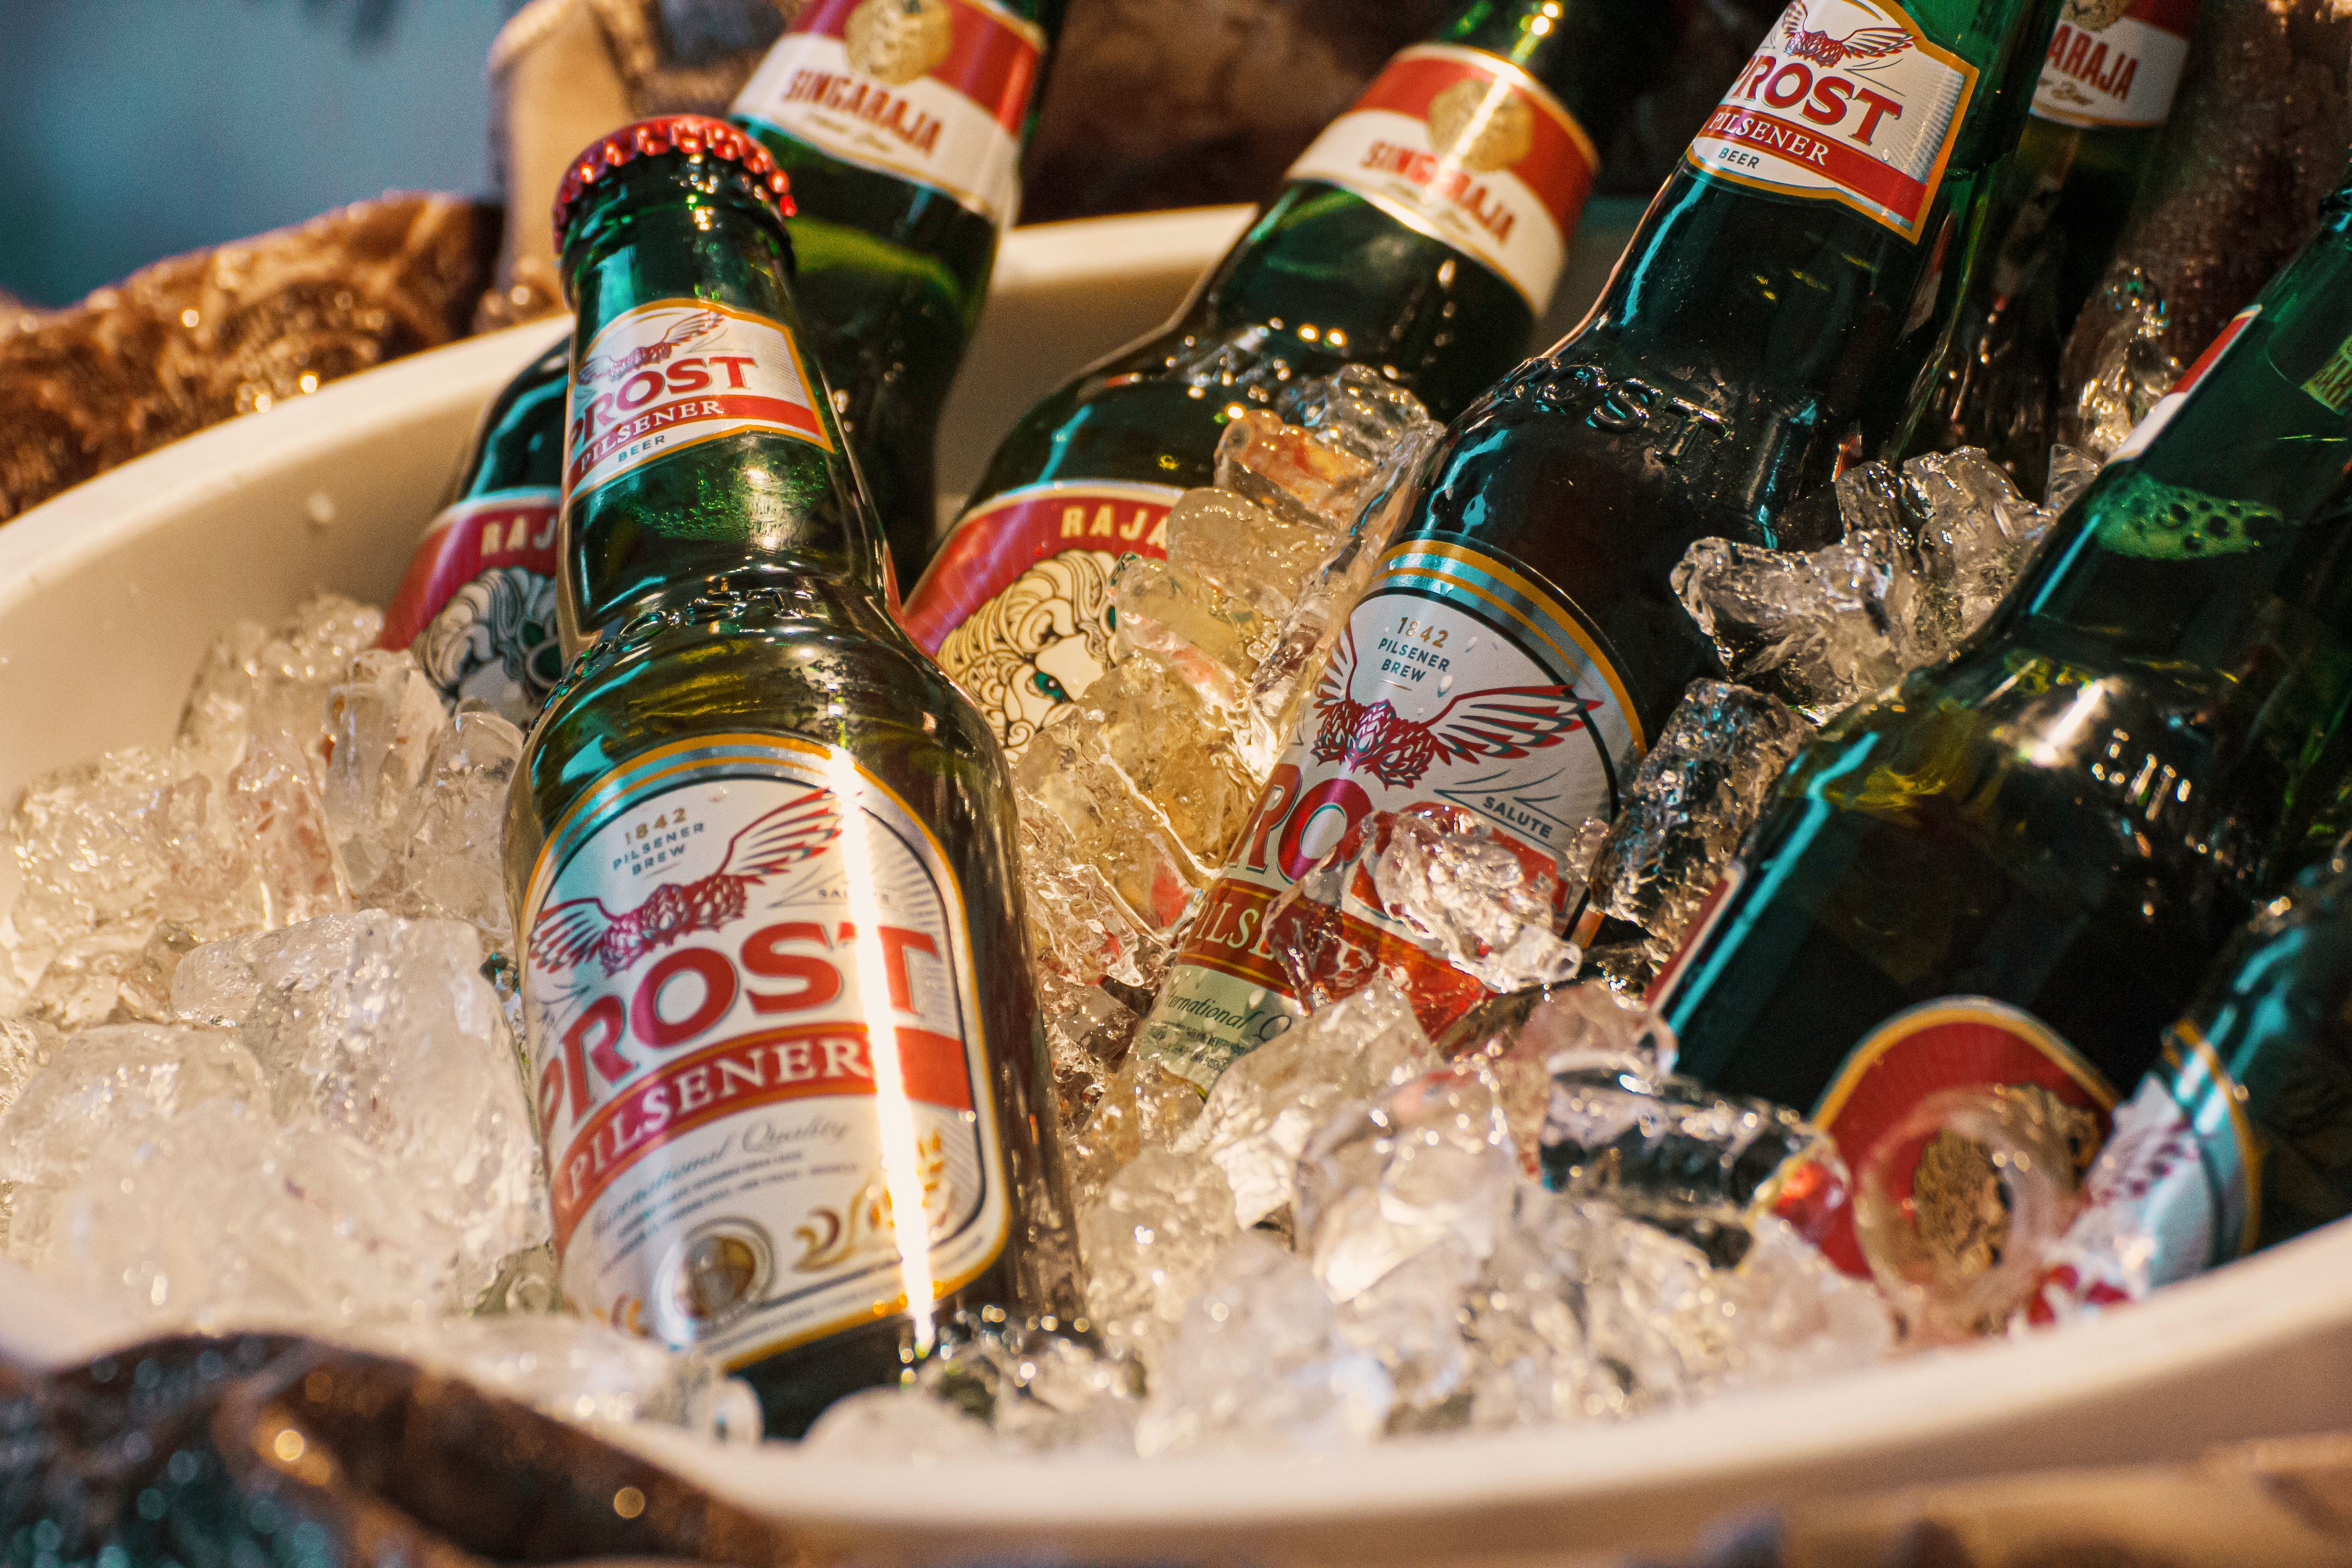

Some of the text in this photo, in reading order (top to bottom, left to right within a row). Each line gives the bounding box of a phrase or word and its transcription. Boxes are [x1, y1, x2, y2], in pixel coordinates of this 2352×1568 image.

[2047, 25, 2138, 102] ARAJA
[1708, 112, 1829, 167] PILSENER
[1718, 147, 1760, 169] BEER
[580, 399, 725, 473] PILSENER
[618, 434, 666, 463] BEER
[480, 515, 557, 557] RAJ
[1396, 617, 1449, 649] 1842
[1377, 637, 1450, 672] PILSENER
[1381, 658, 1427, 682] BREW
[624, 807, 687, 846] 1842
[1482, 796, 1553, 838] SALUTE
[612, 822, 704, 872] PILSENER
[631, 843, 685, 876] BREW
[566, 1036, 877, 1203] PILSENER
